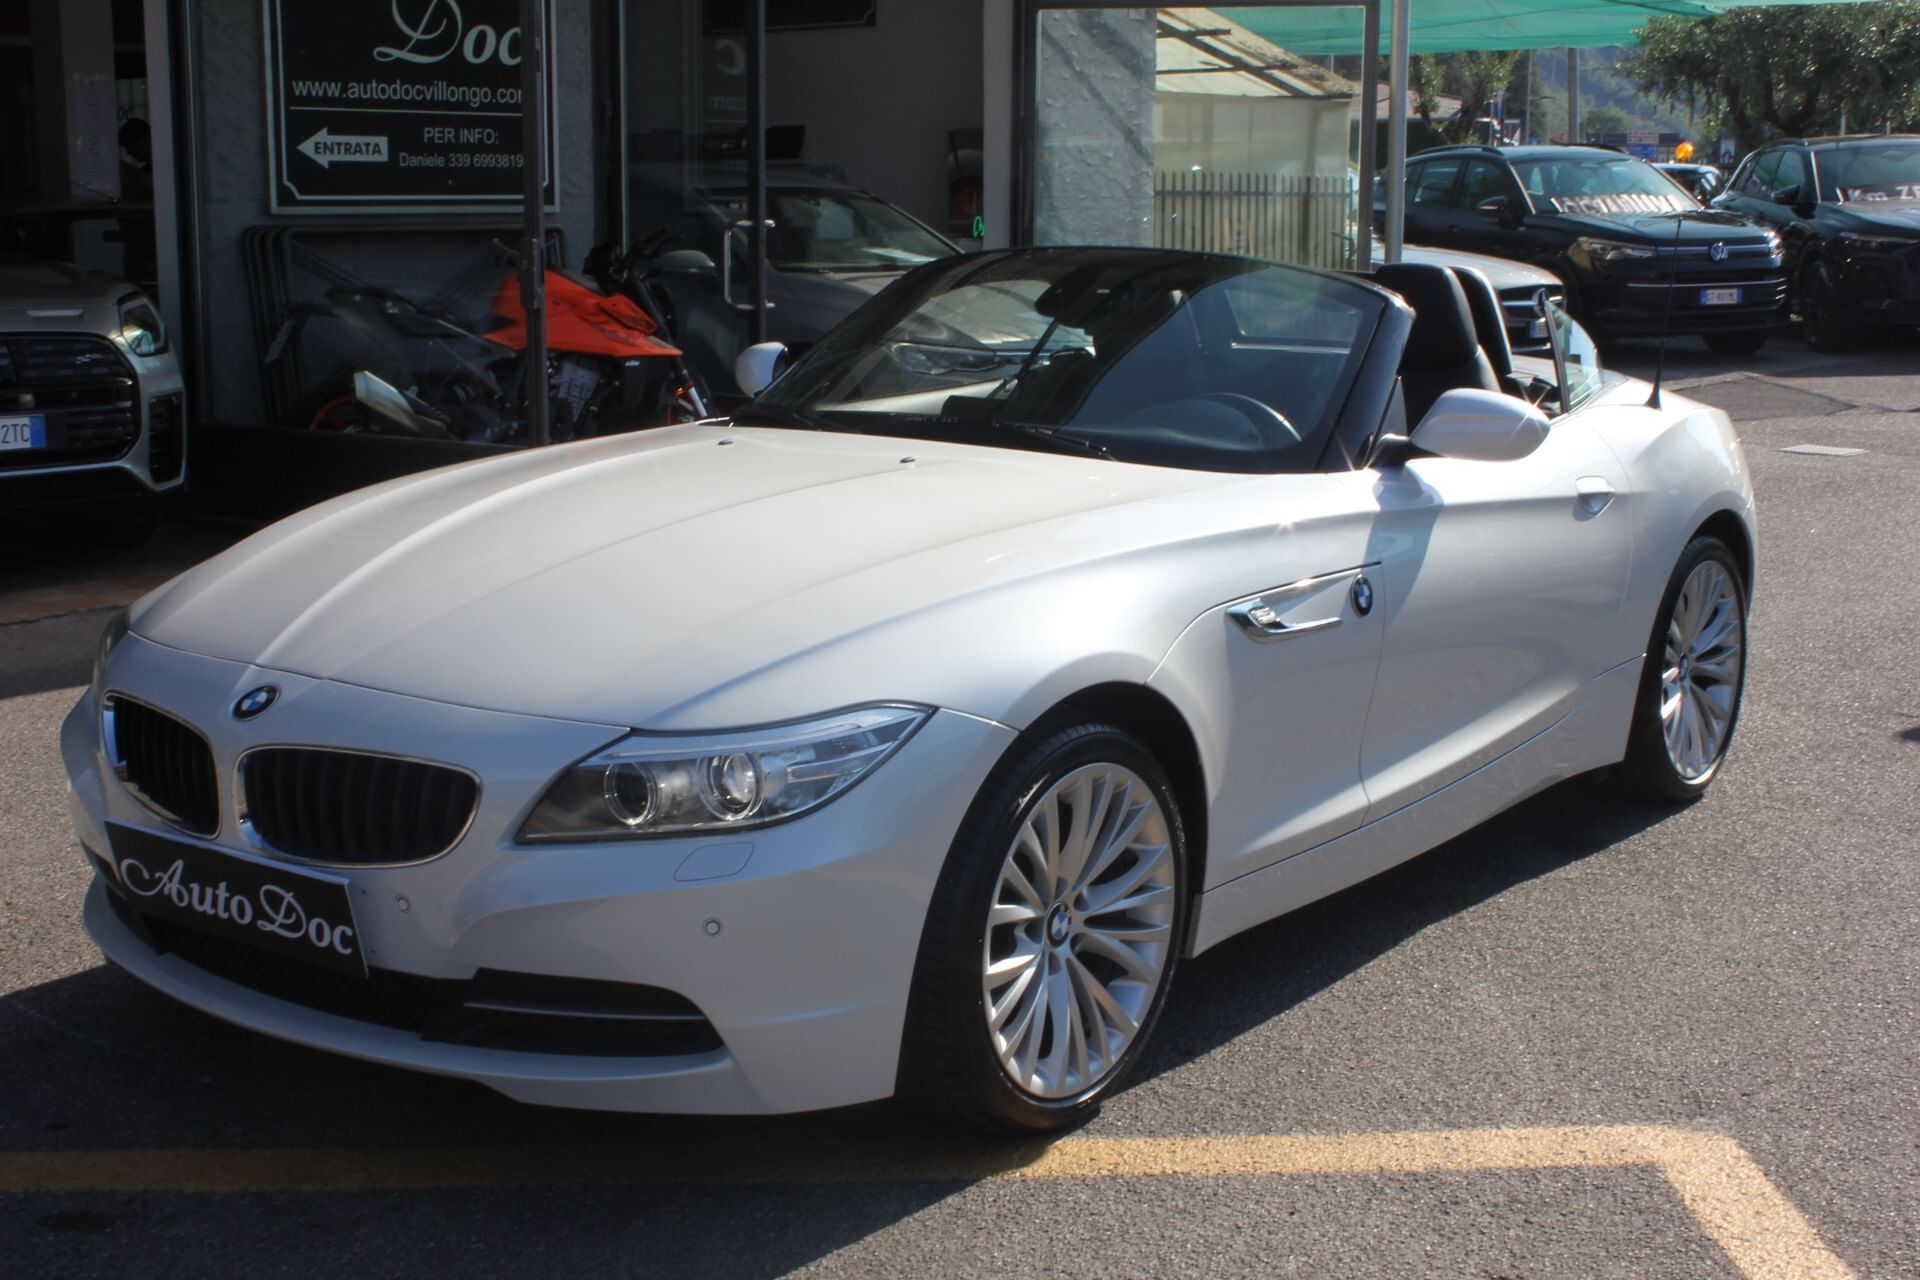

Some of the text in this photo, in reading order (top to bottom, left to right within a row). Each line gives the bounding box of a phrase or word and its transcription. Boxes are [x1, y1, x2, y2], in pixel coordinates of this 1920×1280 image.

[373, 0, 521, 66] Doc
[423, 127, 499, 145] PER INFO:
[313, 141, 383, 156] ENTRATA
[400, 153, 524, 168] Daniele 339 6993819
[1, 423, 30, 444] 2TC
[120, 859, 353, 954] Auto Doc
